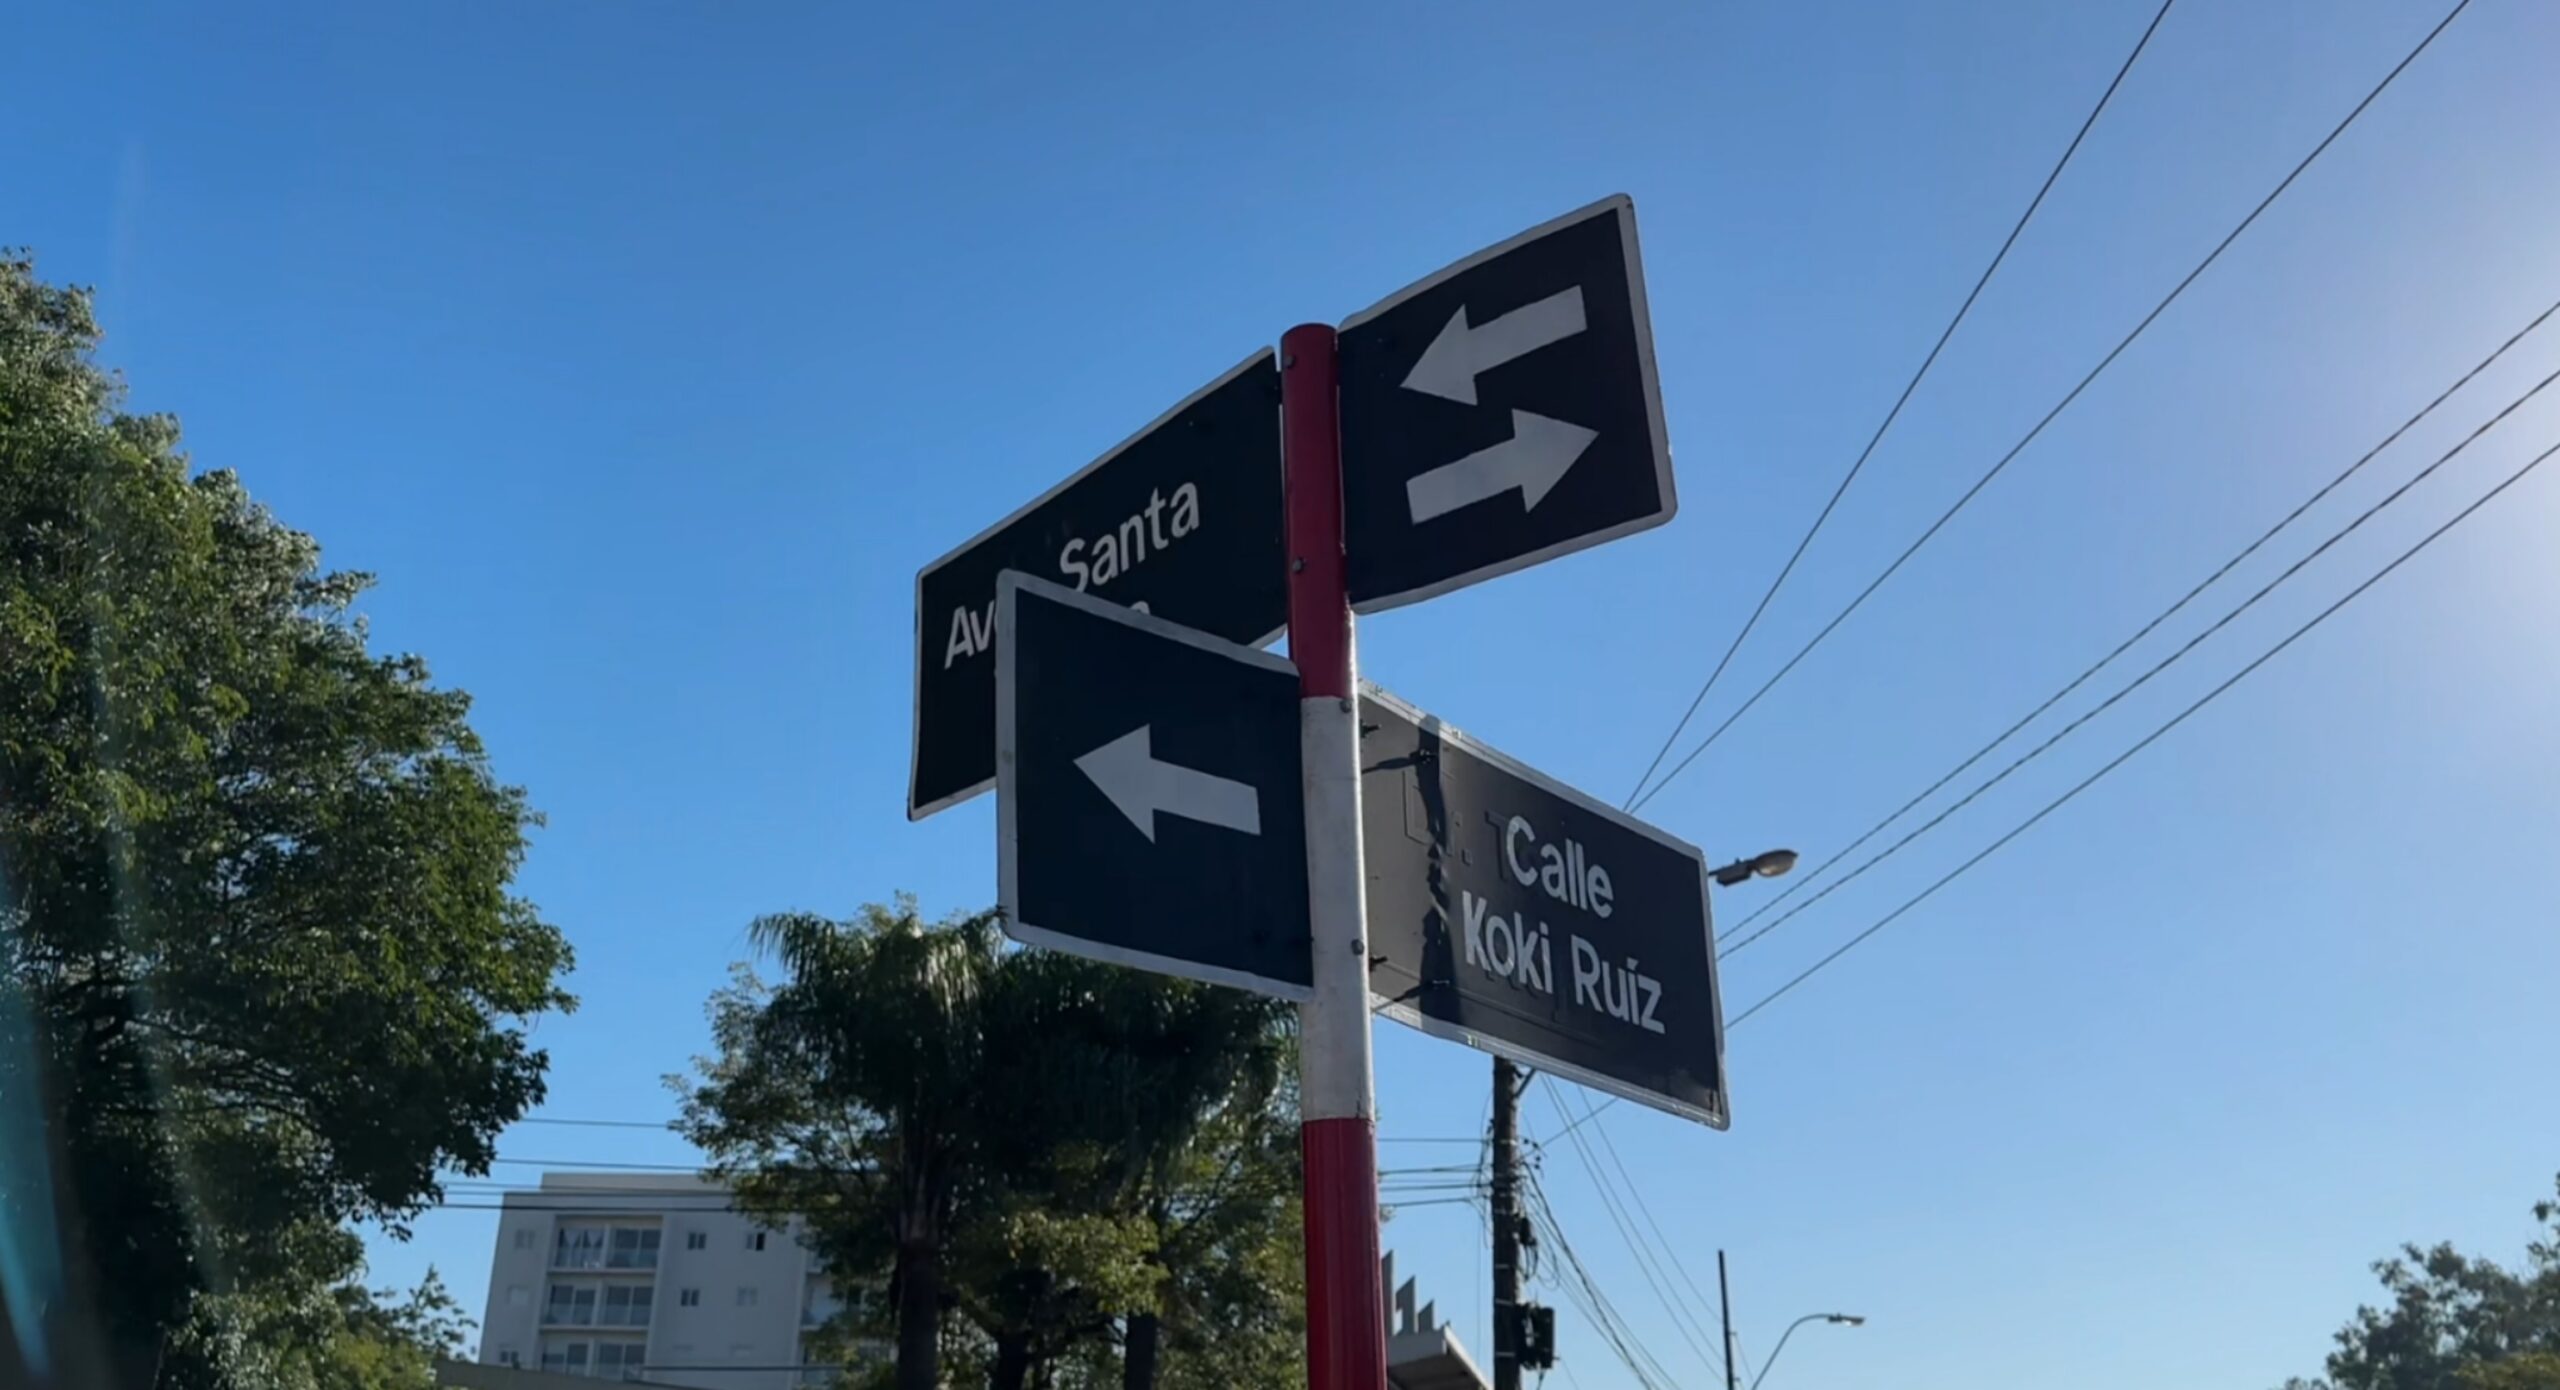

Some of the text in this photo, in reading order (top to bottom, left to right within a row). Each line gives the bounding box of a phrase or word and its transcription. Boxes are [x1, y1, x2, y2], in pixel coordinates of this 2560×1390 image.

[944, 482, 1200, 670] Av Santa
[1506, 815, 1614, 918] Calle
[1462, 891, 1665, 1034] Koki Ruíz
